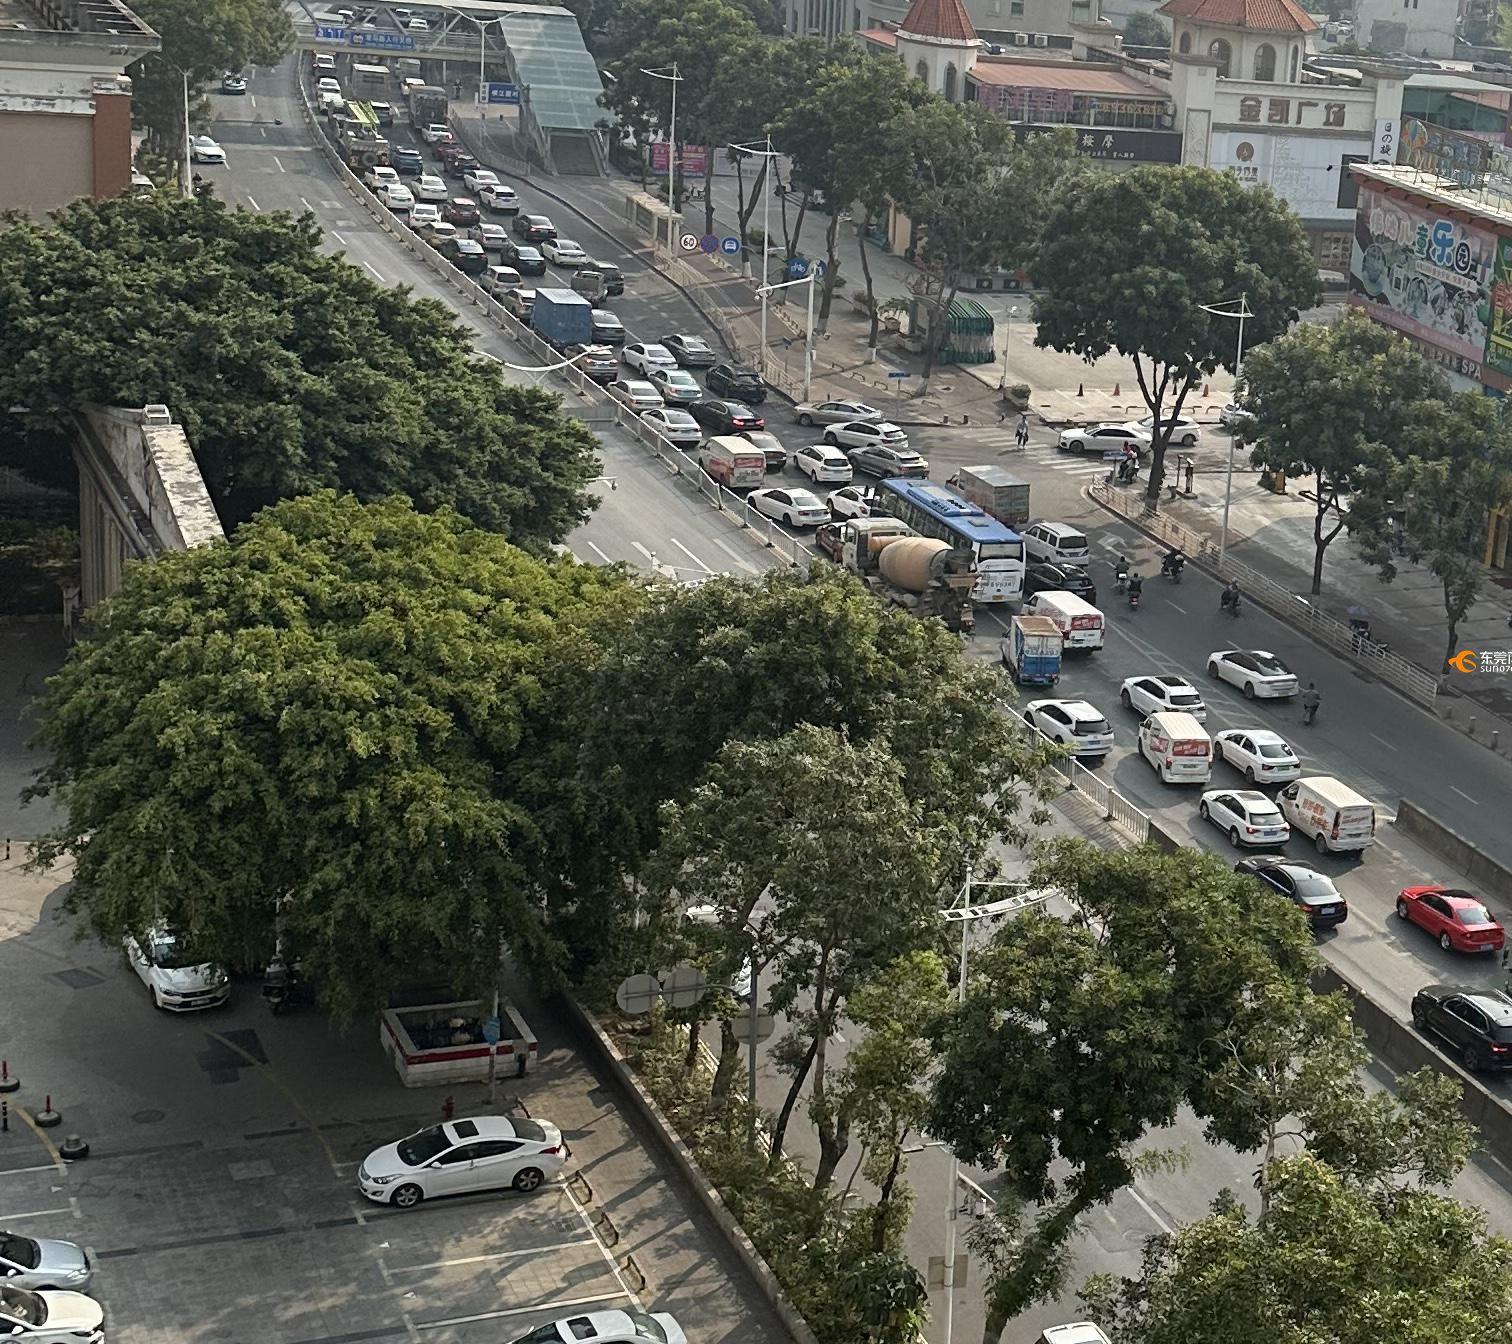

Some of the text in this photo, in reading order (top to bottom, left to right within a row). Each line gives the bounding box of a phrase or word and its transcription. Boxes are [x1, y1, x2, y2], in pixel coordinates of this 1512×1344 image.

[1239, 96, 1346, 127] 金凯广场
[683, 237, 695, 247] 60
[1461, 358, 1483, 381] SPA
